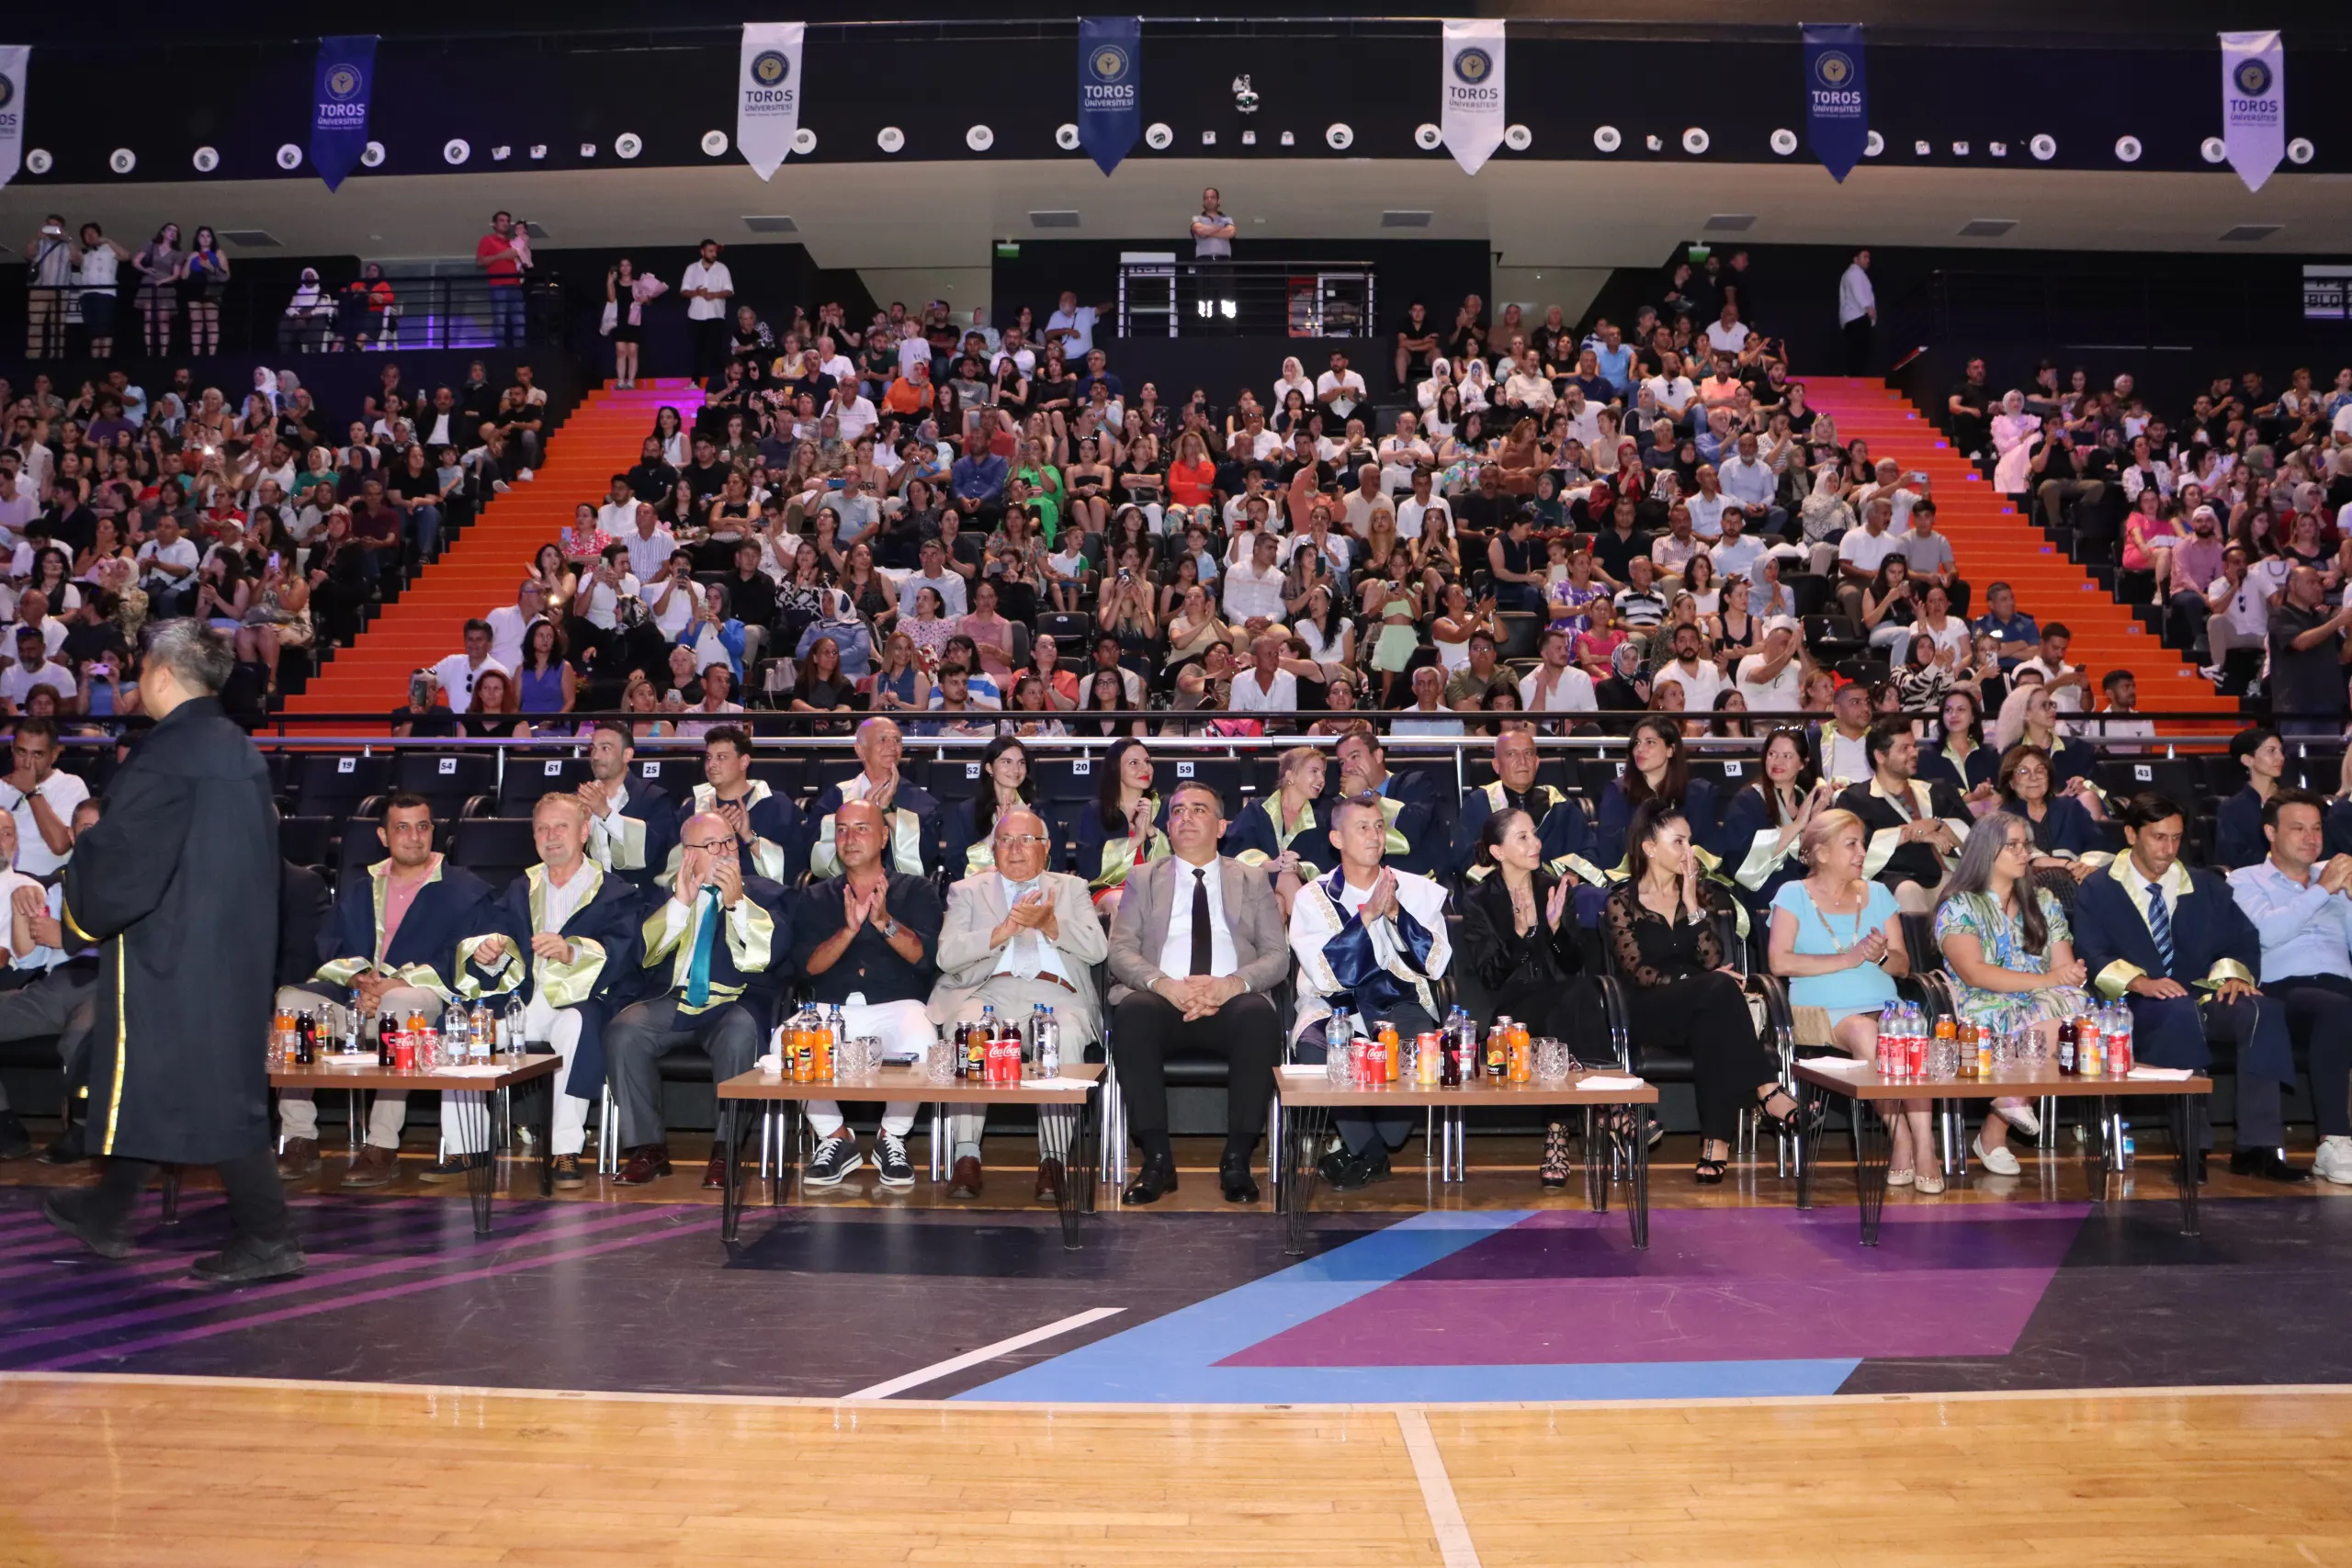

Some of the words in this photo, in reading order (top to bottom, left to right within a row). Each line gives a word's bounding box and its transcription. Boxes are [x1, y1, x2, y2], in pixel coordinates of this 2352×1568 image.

[745, 89, 794, 103] TOROS
[1084, 85, 1135, 98] TOROS
[1449, 85, 1498, 99] TOROS
[1812, 90, 1861, 104] TOROS
[1084, 97, 1134, 107] ÜNİVERSİTESİ
[2230, 99, 2278, 113] TOROS
[319, 103, 366, 117] TOROS
[342, 761, 353, 770] 19
[440, 761, 453, 771] 54
[548, 764, 559, 773] 61
[645, 766, 657, 774] 25
[1075, 763, 1088, 772] 20
[1179, 766, 1192, 774] 59
[1726, 764, 1737, 773] 57
[967, 766, 978, 775] 52
[2137, 769, 2149, 777] 43
